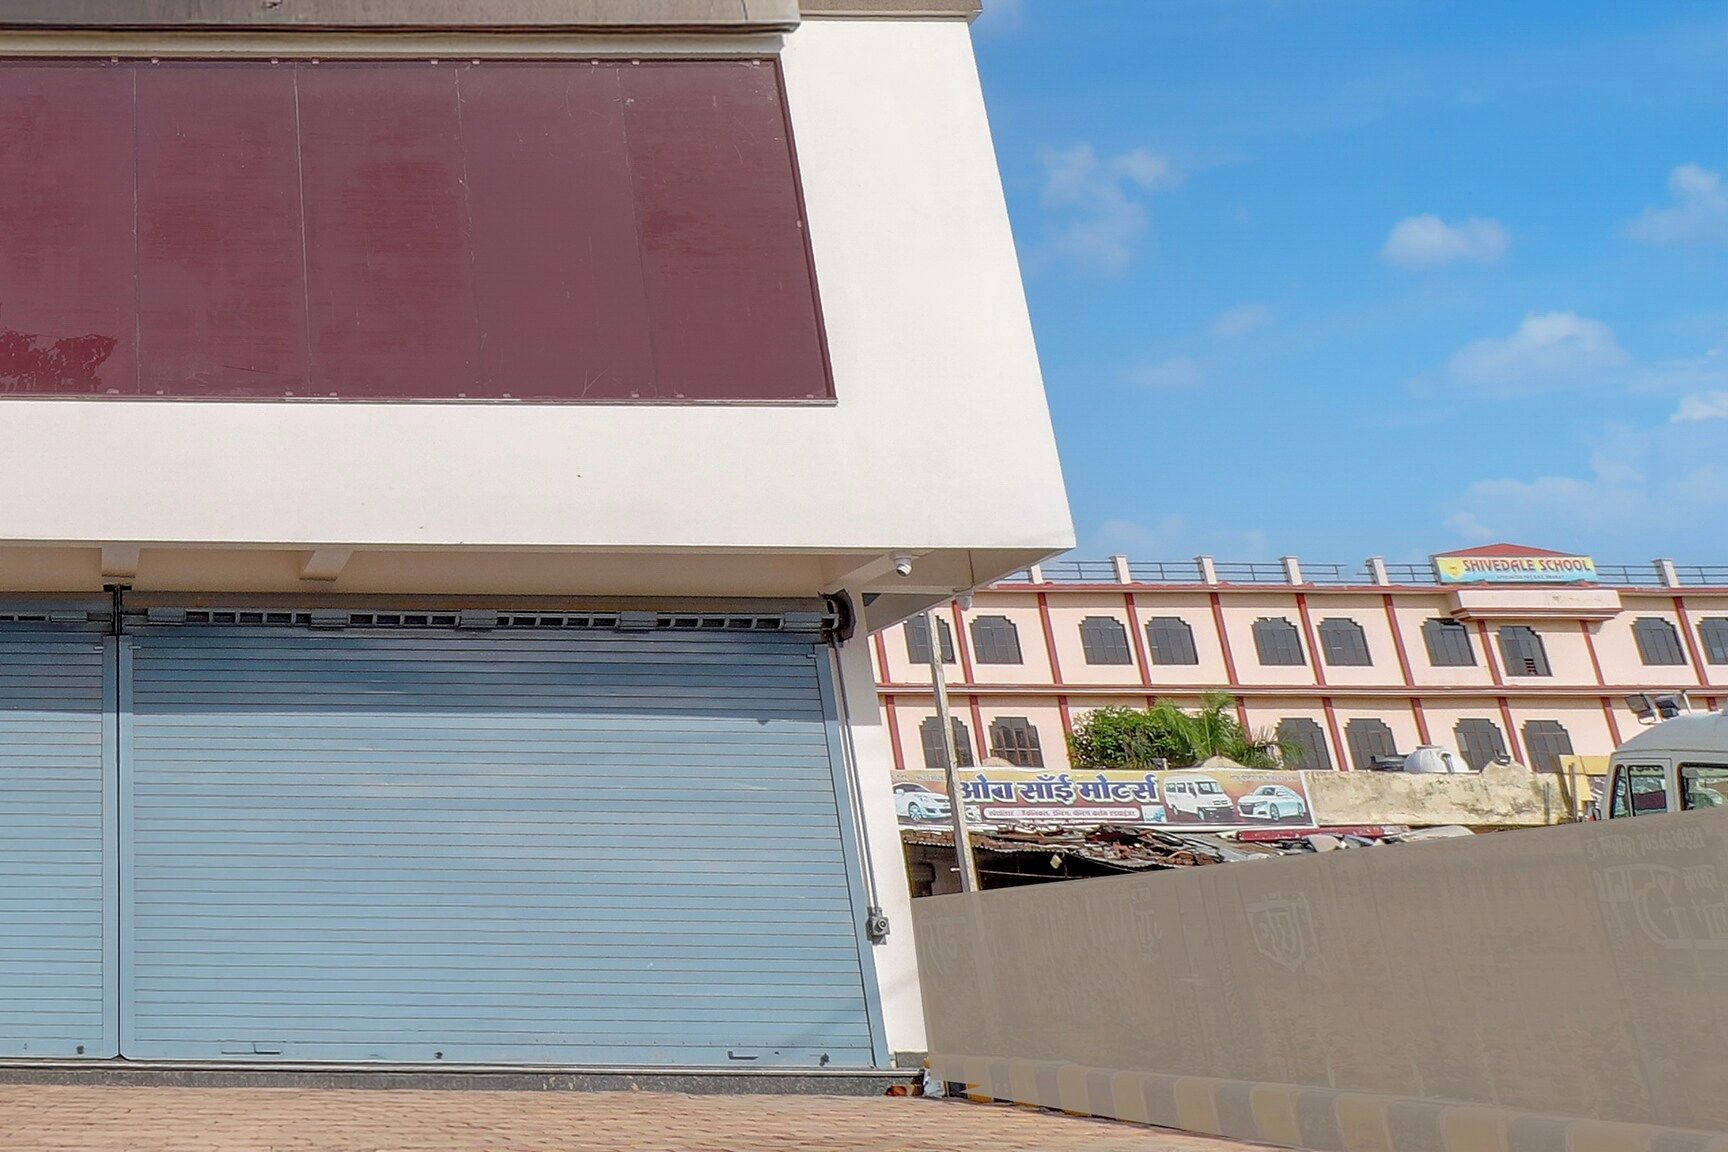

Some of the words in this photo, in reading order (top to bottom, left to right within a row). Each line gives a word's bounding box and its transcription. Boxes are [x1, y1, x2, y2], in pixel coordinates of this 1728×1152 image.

[1462, 559, 1536, 573] SHIVEDALE
[1538, 559, 1591, 572] SCHOOL
[1076, 774, 1160, 802] मोटर्स
